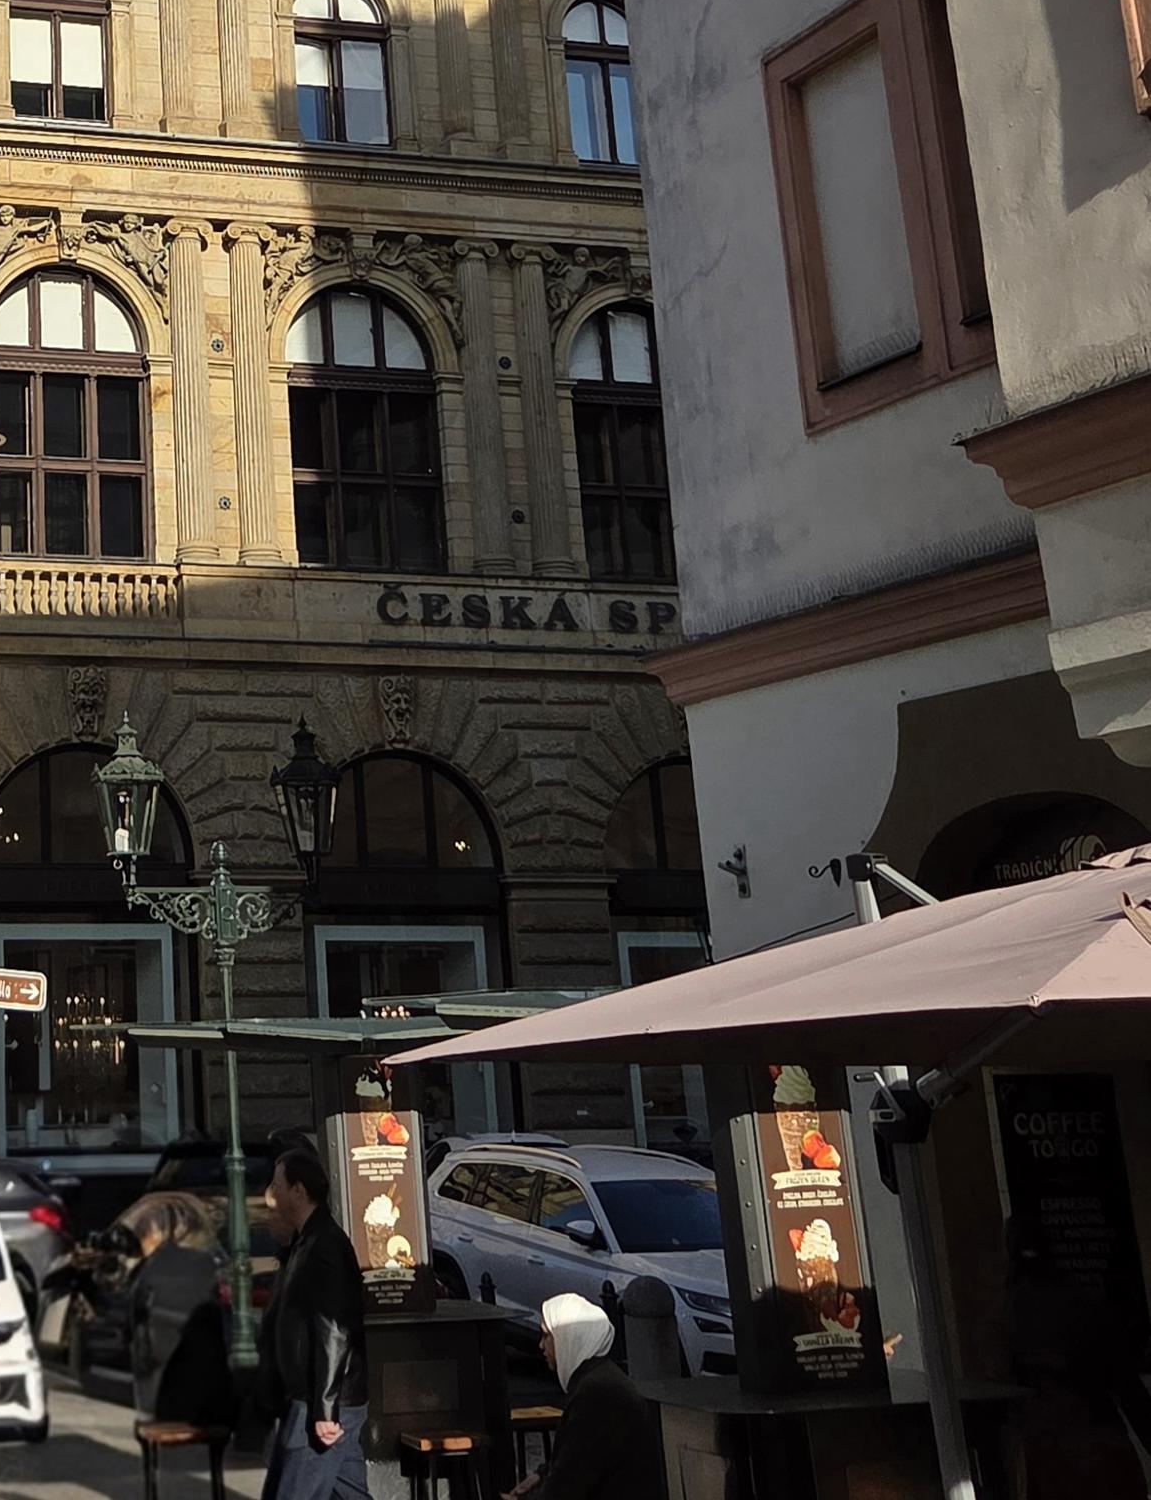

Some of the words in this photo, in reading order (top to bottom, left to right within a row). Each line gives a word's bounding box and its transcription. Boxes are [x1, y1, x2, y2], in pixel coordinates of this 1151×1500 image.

[376, 582, 579, 632] ČESKÁ
[1013, 1111, 1105, 1134] COFFEE
[1027, 1138, 1056, 1159] TO
[1071, 1138, 1100, 1157] GO
[1040, 1197, 1102, 1211] ESPRESSO
